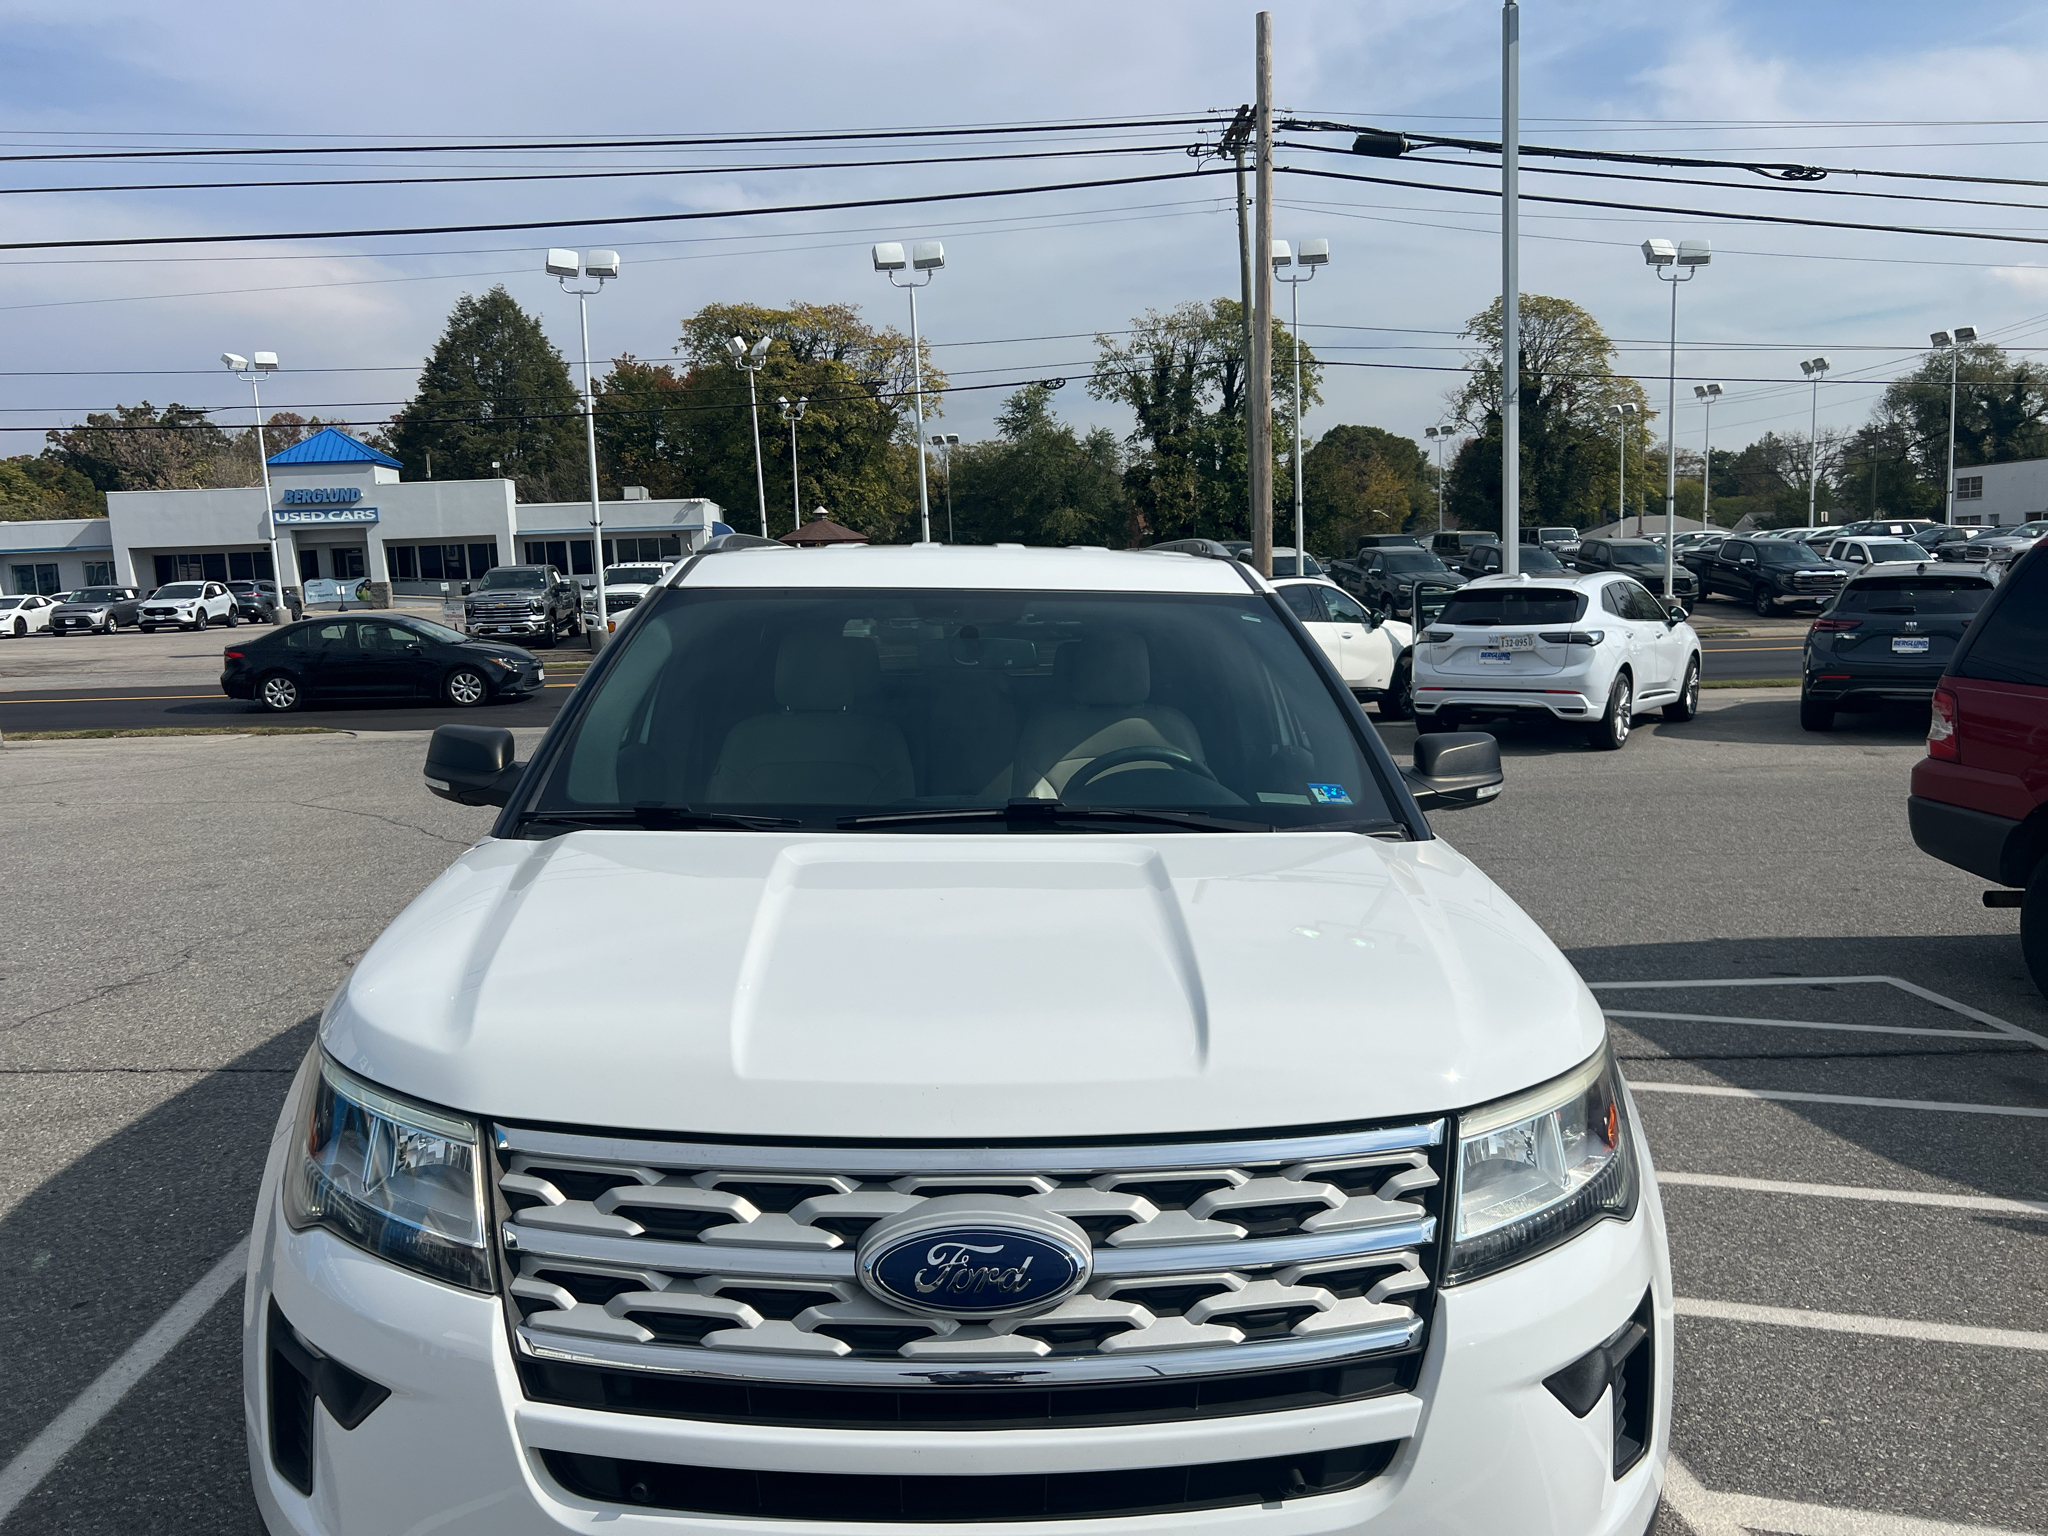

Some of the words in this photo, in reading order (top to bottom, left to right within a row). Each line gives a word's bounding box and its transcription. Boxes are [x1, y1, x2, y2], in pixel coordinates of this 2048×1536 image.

[283, 488, 361, 504] BERGLUND
[275, 511, 325, 522] USED
[328, 510, 376, 520] CARS
[1480, 651, 1511, 660] BERGLUND
[914, 1242, 1034, 1294] Ford
